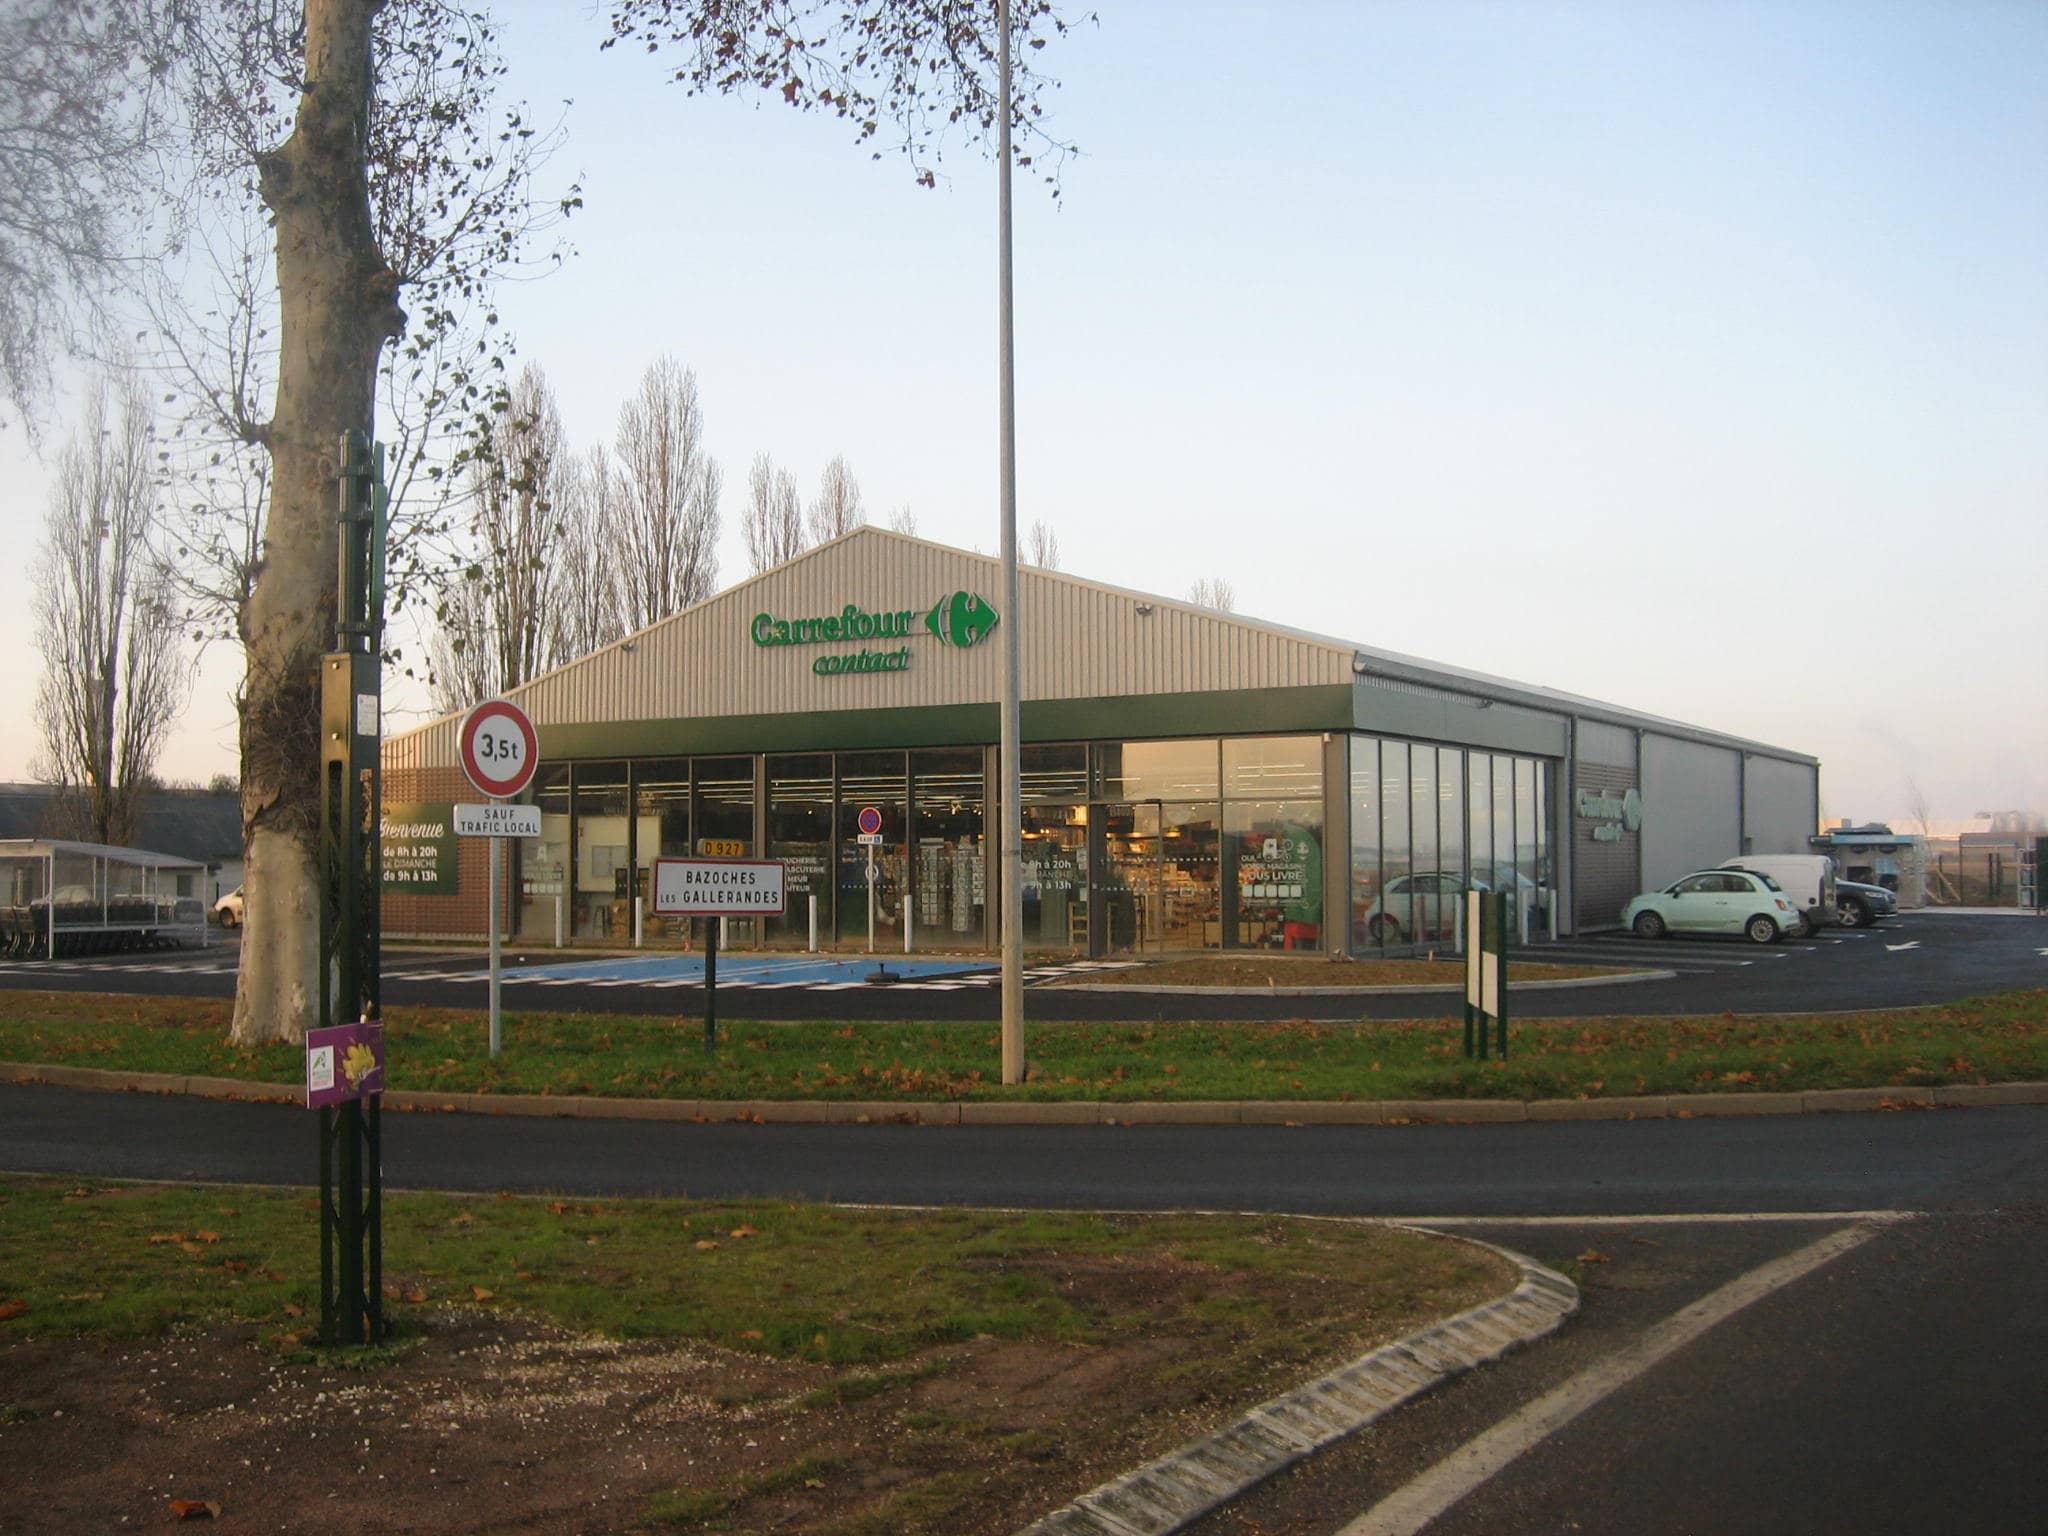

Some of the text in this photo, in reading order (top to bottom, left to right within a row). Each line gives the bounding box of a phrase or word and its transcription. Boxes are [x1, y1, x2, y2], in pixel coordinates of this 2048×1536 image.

[751, 604, 913, 647] Carrefour
[812, 646, 911, 675] contact
[484, 808, 515, 820] SAUF
[380, 817, 445, 839] Bienvenue
[461, 821, 538, 834] TRAFIC LOCAL
[383, 847, 395, 857] de
[411, 846, 418, 857] à
[419, 847, 438, 857] 20h
[704, 842, 740, 856] D 927
[394, 859, 437, 868] DIMANCHE
[1052, 860, 1072, 869] 20h
[383, 870, 438, 881] de 9h à 13h
[686, 871, 756, 885] BAZOCHES
[1272, 872, 1303, 881] LIVRE
[1054, 880, 1072, 890] 13h
[683, 891, 779, 904] GALLERANDES
